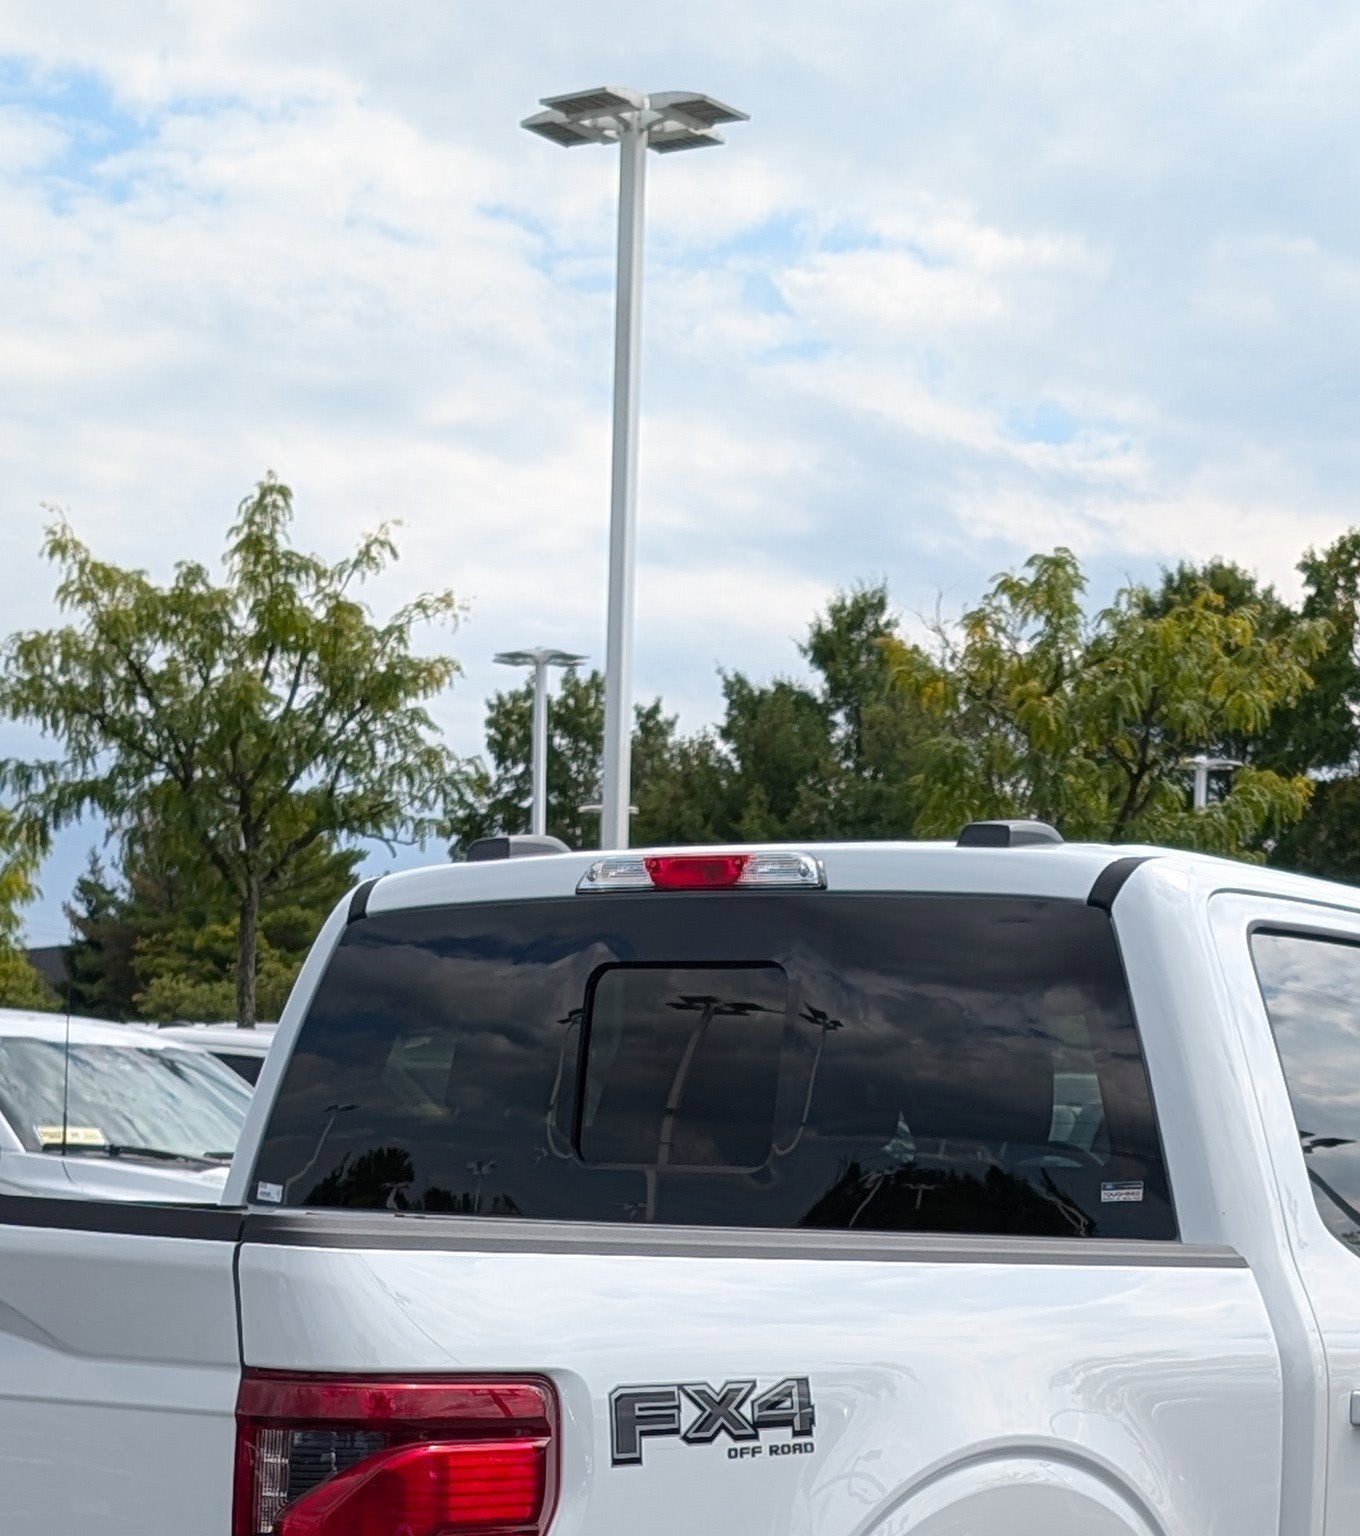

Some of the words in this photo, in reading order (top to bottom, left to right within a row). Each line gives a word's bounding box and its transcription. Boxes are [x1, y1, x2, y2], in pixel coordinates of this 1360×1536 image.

[608, 1376, 815, 1467] FX4
[728, 1445, 762, 1459] OFF
[769, 1442, 815, 1457] ROAD
